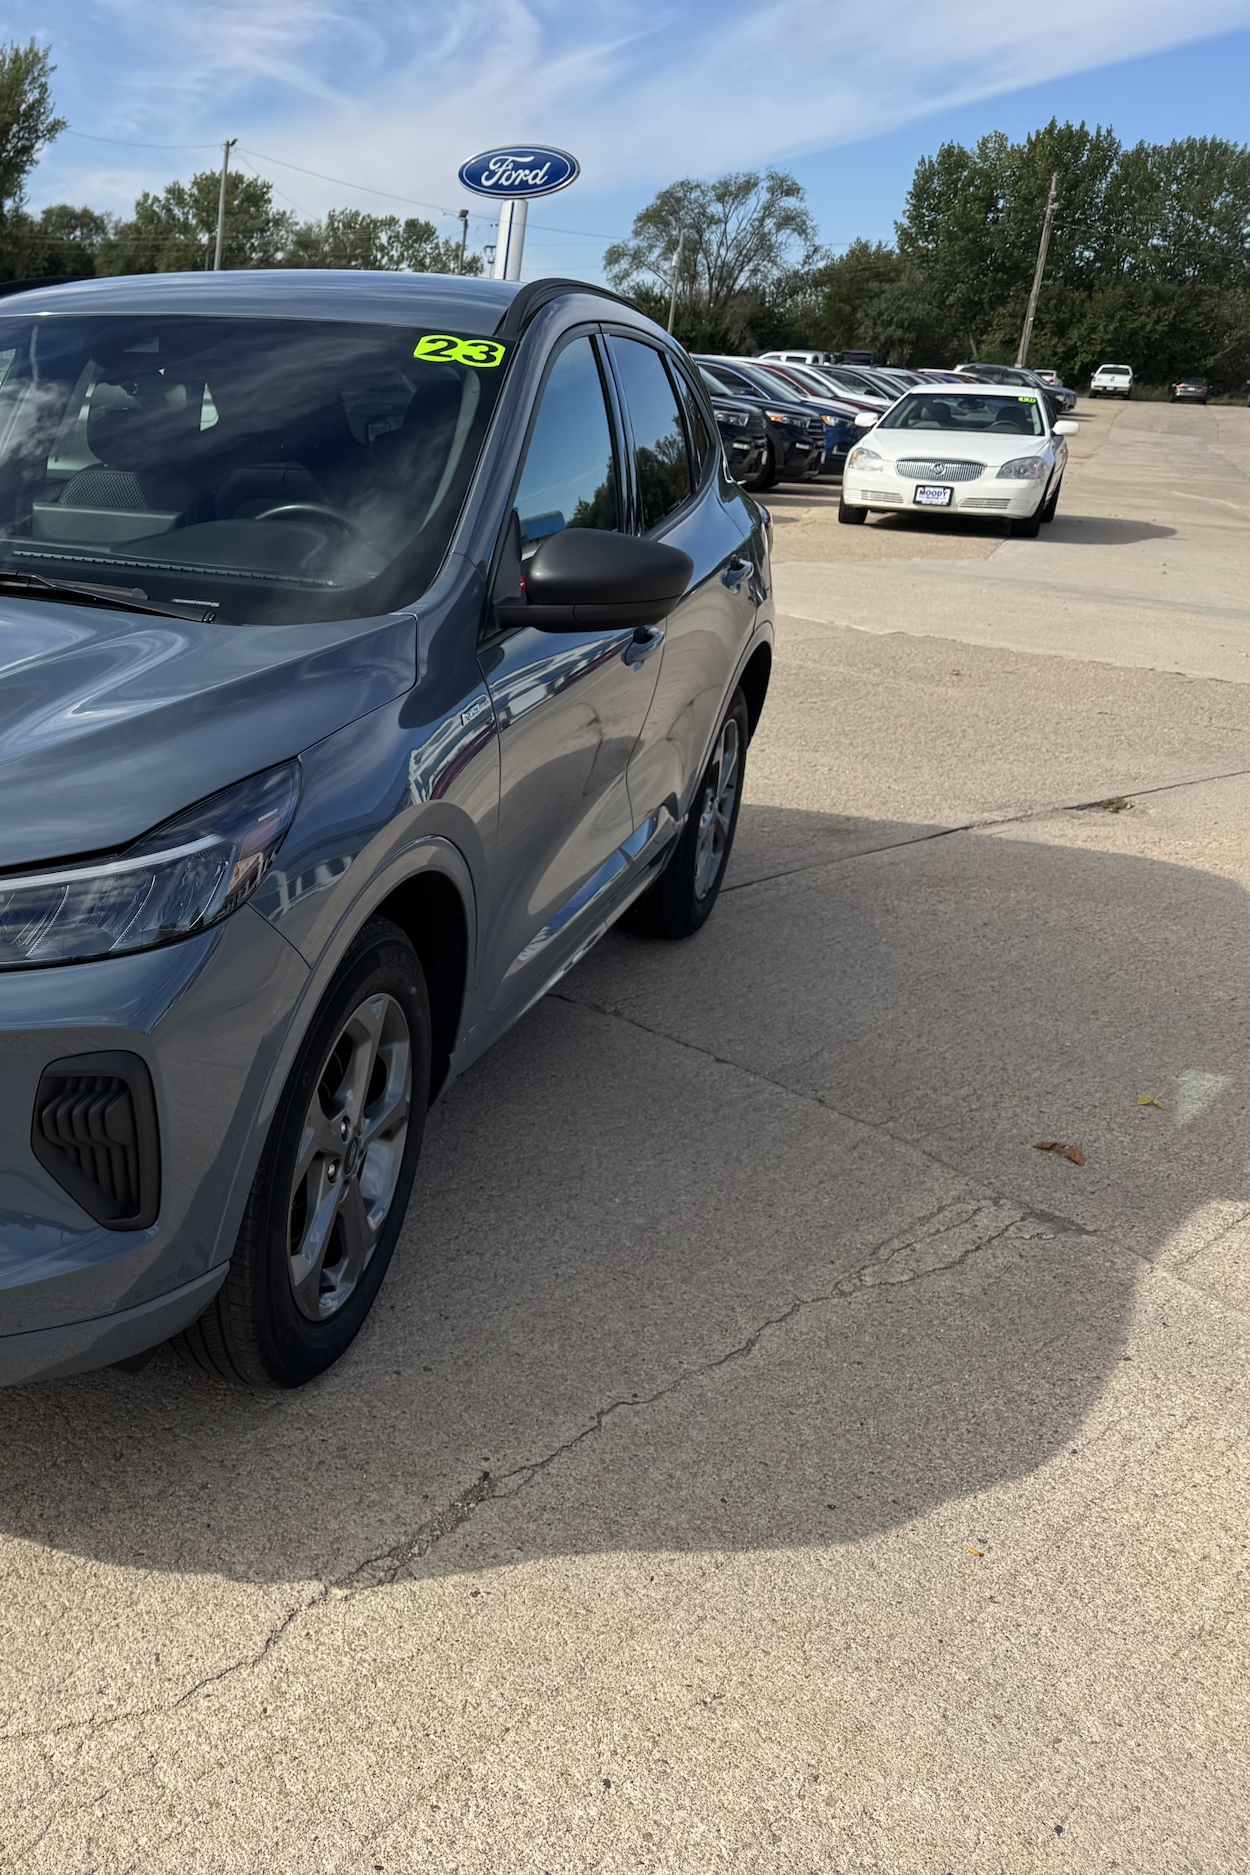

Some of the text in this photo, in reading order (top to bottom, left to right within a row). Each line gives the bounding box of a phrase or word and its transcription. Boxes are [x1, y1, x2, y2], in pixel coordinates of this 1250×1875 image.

[481, 156, 551, 187] Ford
[419, 338, 498, 363] 23
[919, 487, 947, 497] MOODY
